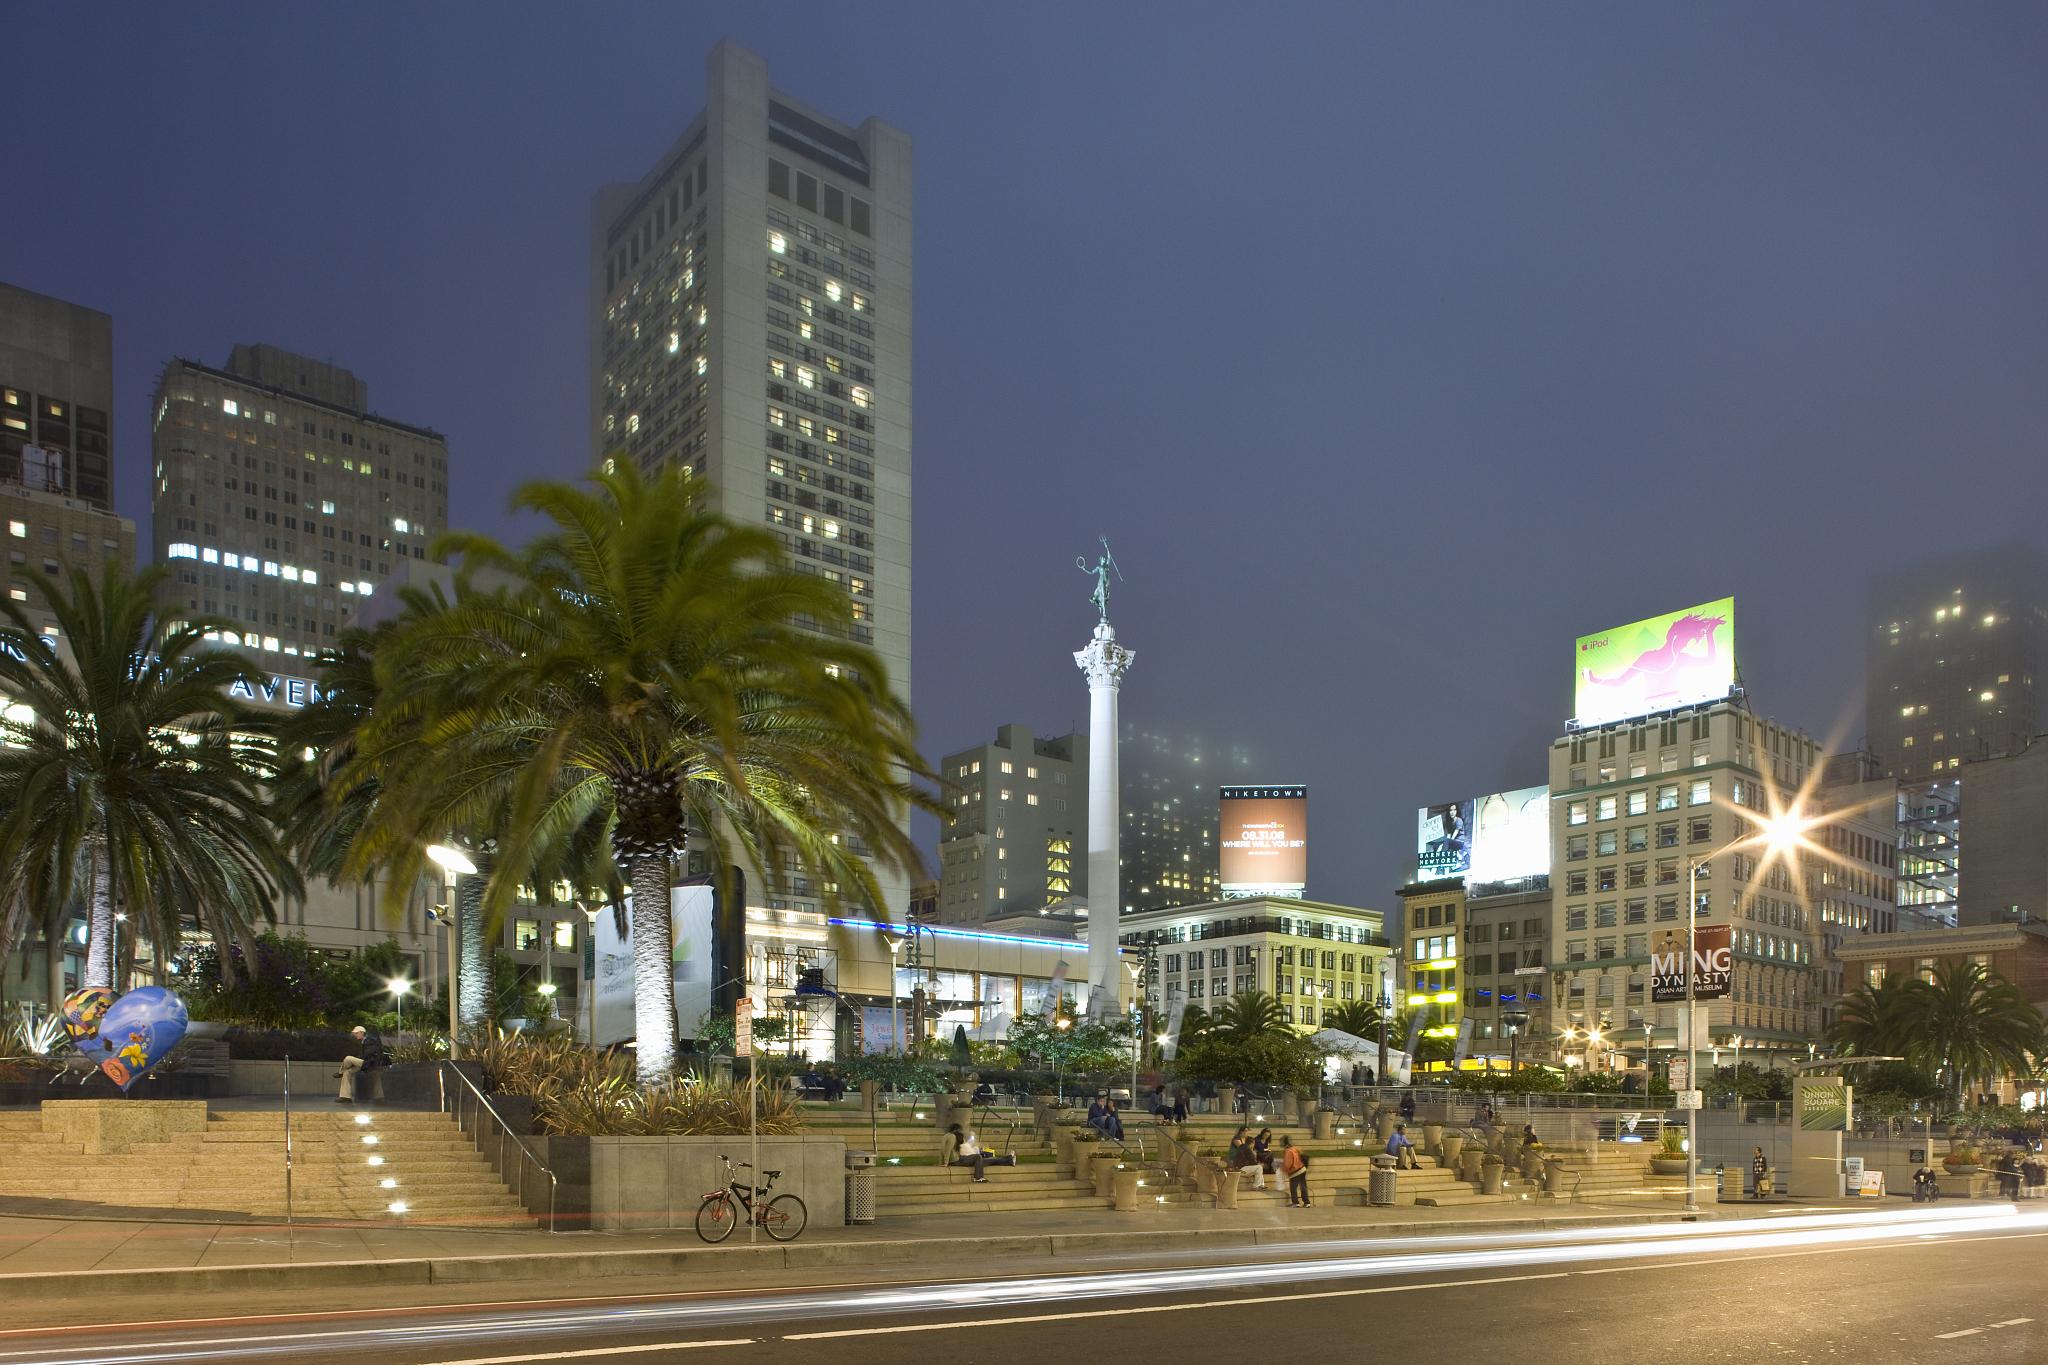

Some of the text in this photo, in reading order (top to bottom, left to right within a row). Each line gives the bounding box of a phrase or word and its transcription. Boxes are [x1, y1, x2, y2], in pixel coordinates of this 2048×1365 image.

[1590, 636, 1609, 650] iPod
[229, 674, 338, 708] AVEN
[1224, 790, 1303, 798] NIKETOWN
[1241, 830, 1285, 840] 08.31.08
[1222, 840, 1304, 848] WHERE WILL YOU BE?
[1694, 984, 1723, 992] MUSEUM
[871, 1023, 892, 1034] Jewe
[1804, 1091, 1834, 1099] UNION
[1804, 1098, 1841, 1106] SQUARE
